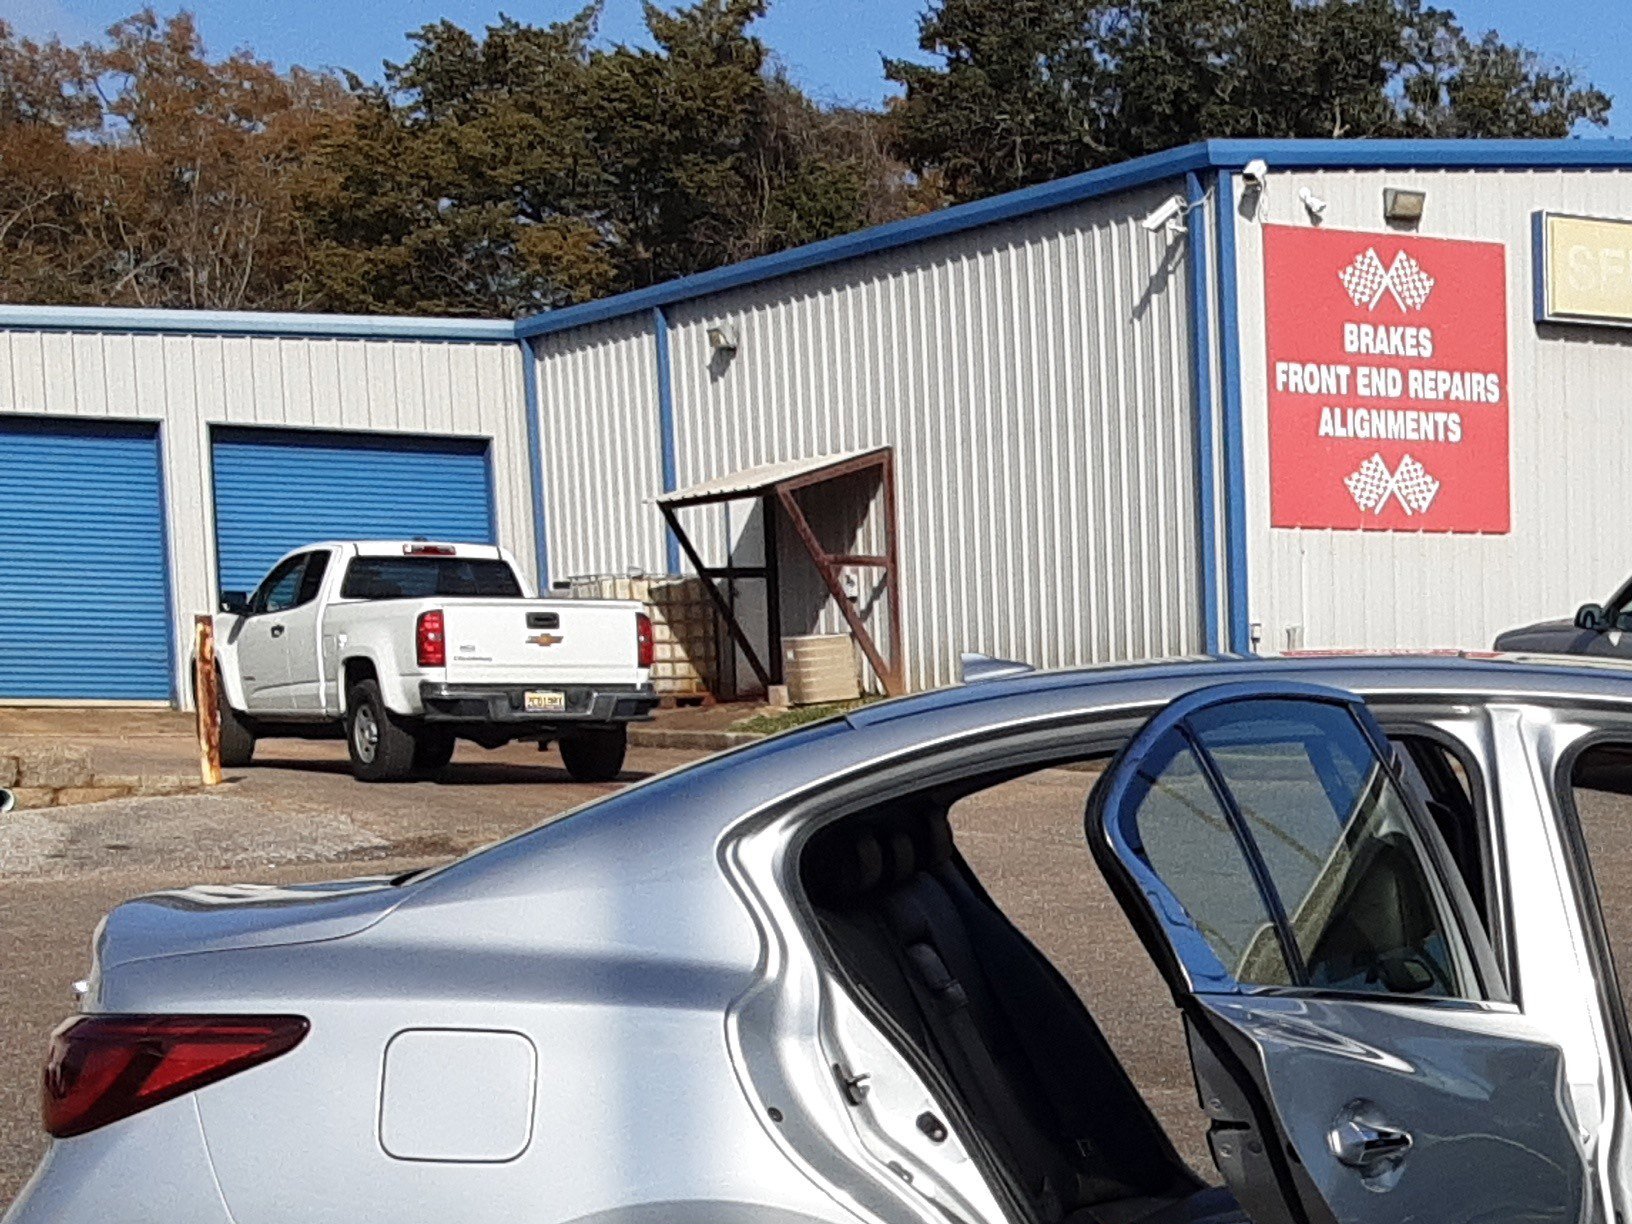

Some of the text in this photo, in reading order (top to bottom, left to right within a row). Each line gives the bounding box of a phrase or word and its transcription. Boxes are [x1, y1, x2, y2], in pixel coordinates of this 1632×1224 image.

[1344, 323, 1433, 357] BRAKES
[1275, 362, 1500, 403] FRONT END REPAIRS
[1318, 407, 1463, 442] ALIGNMENTS
